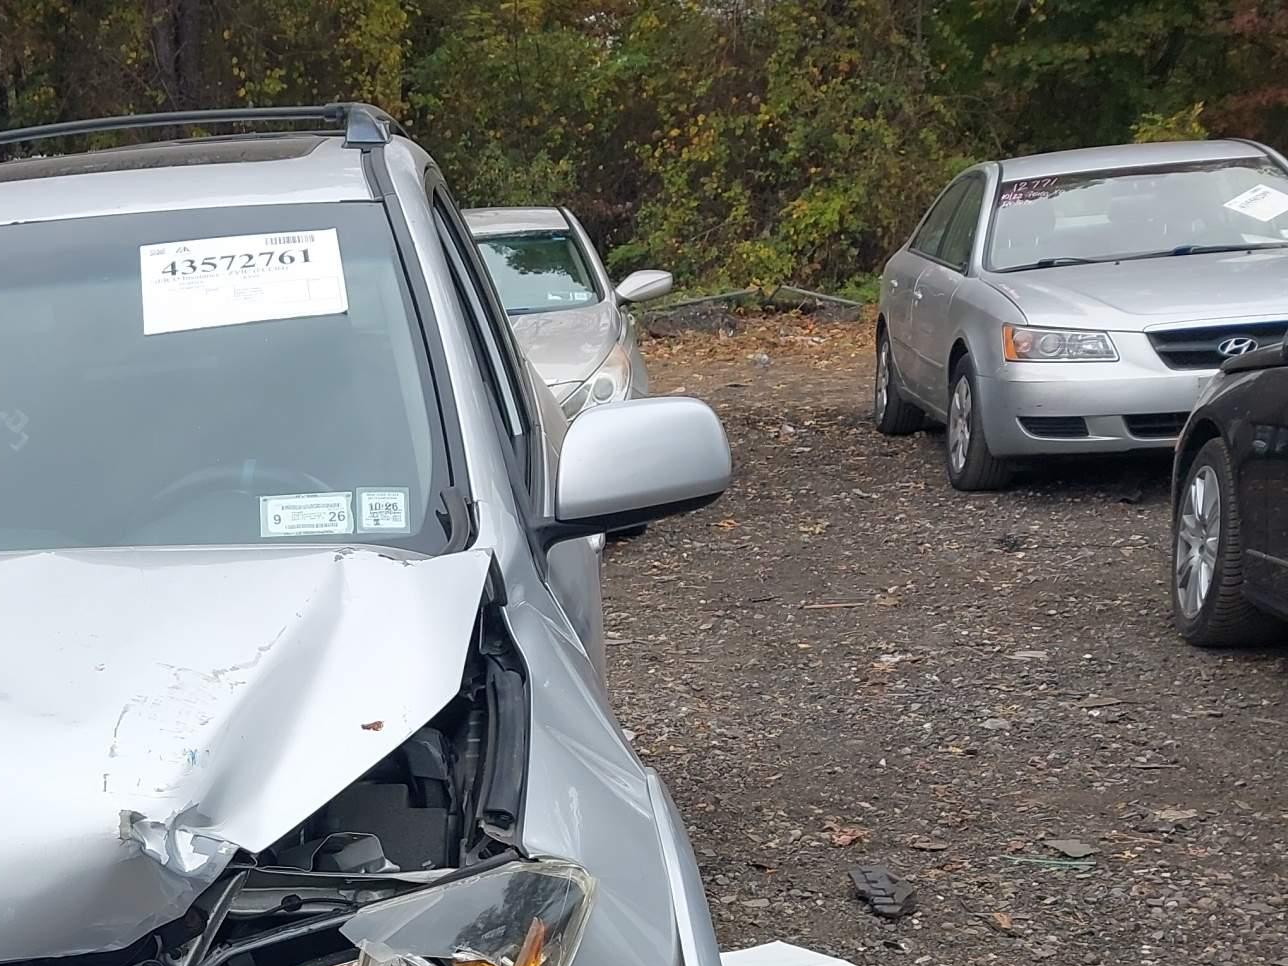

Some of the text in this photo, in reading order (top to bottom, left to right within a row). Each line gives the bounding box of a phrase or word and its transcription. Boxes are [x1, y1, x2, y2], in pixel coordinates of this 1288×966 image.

[162, 248, 312, 276] 43572761
[273, 511, 346, 525] 9 26
